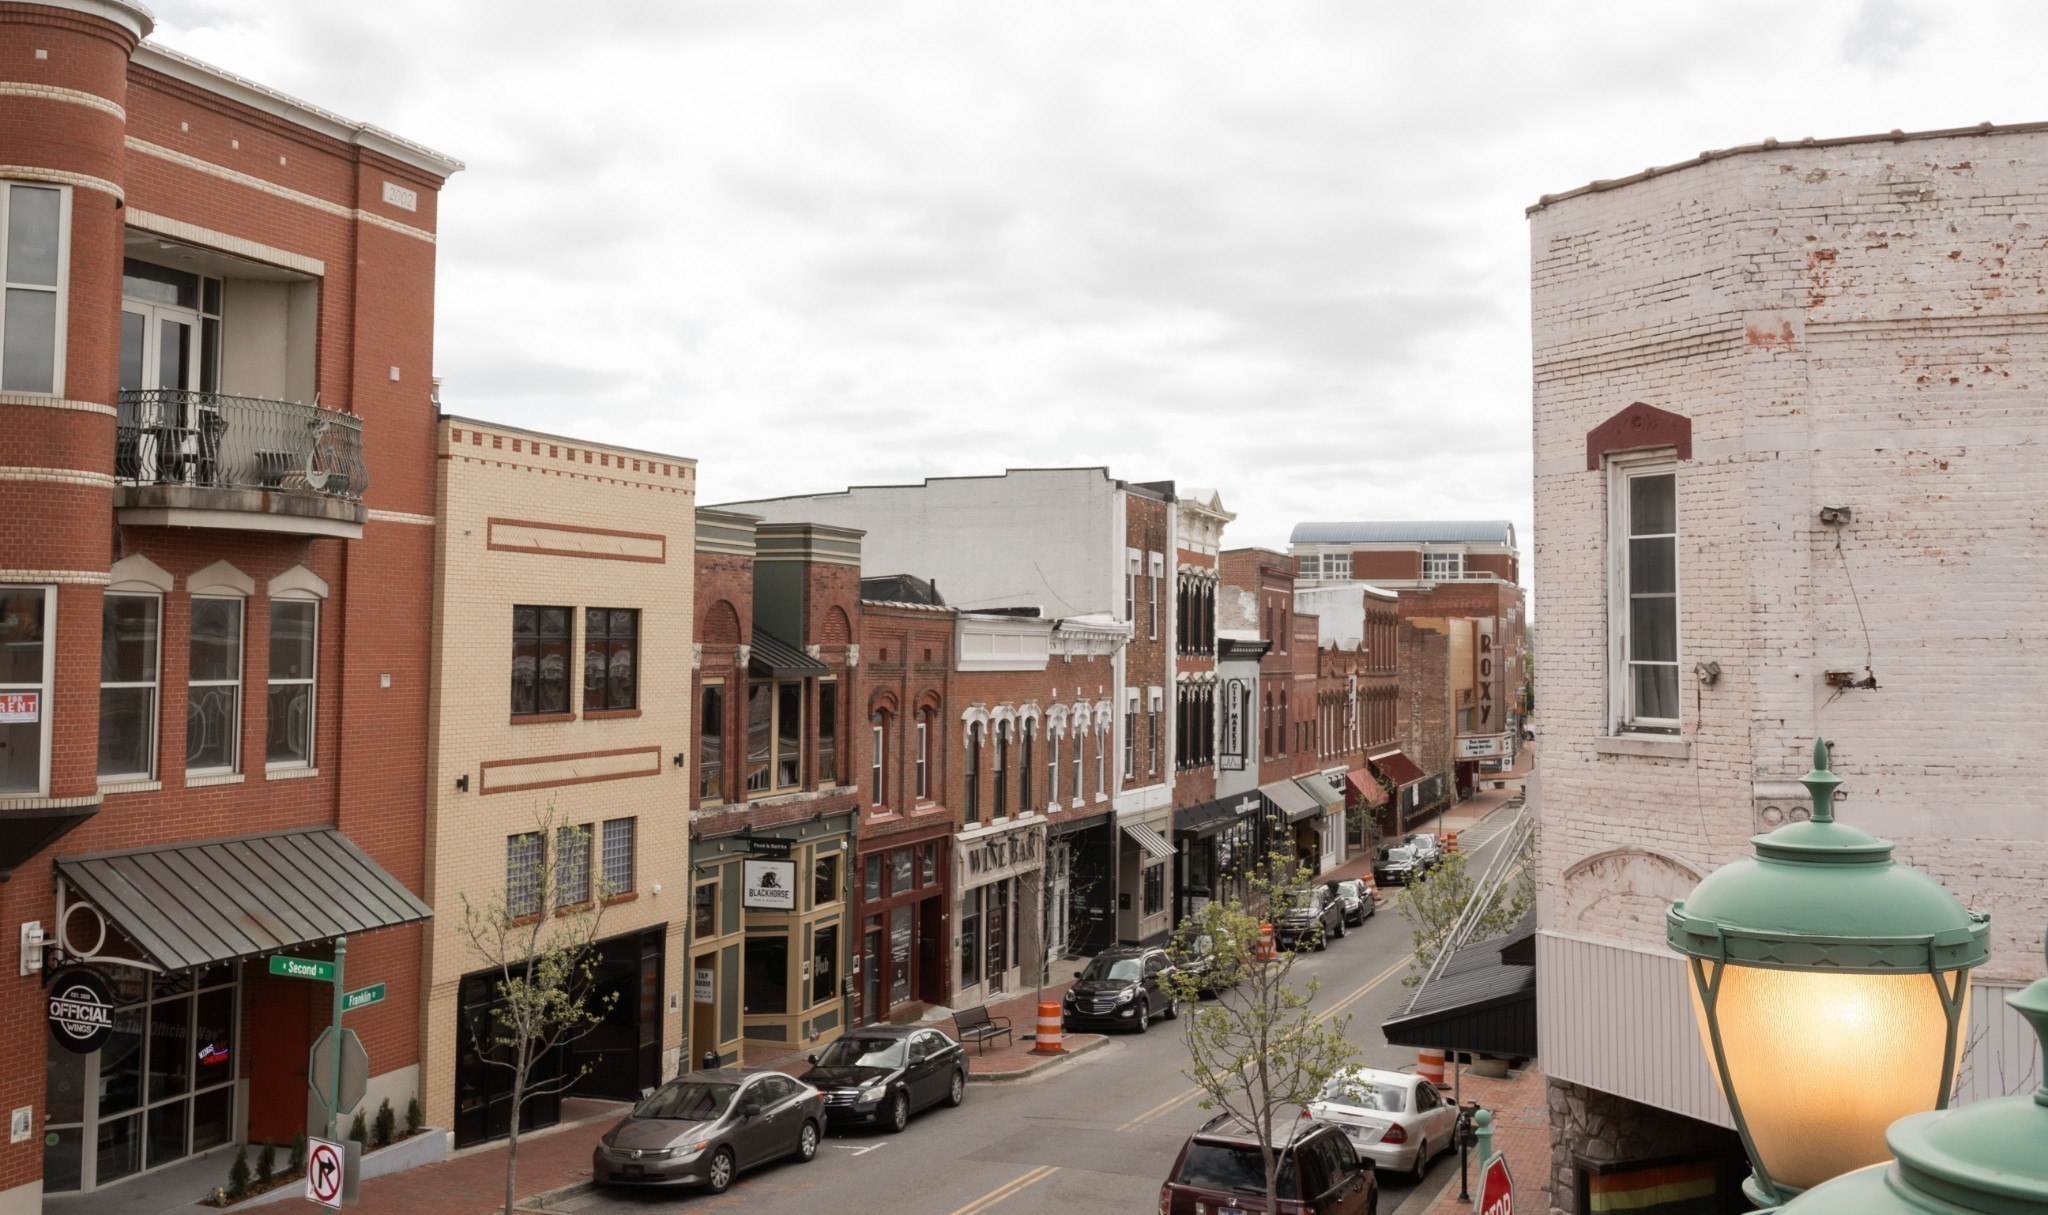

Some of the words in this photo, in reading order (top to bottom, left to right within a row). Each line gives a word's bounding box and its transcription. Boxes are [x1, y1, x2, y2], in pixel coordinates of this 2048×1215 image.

[389, 187, 414, 207] 2002
[1480, 634, 1492, 725] ROXY
[0, 702, 35, 712] RENT
[749, 889, 790, 899] BLACKHORSE
[288, 961, 317, 976] Second
[698, 972, 708, 981] TAP
[349, 992, 372, 1007] Franklin
[50, 1001, 112, 1023] OFFICIAL
[66, 1022, 92, 1033] WINGS
